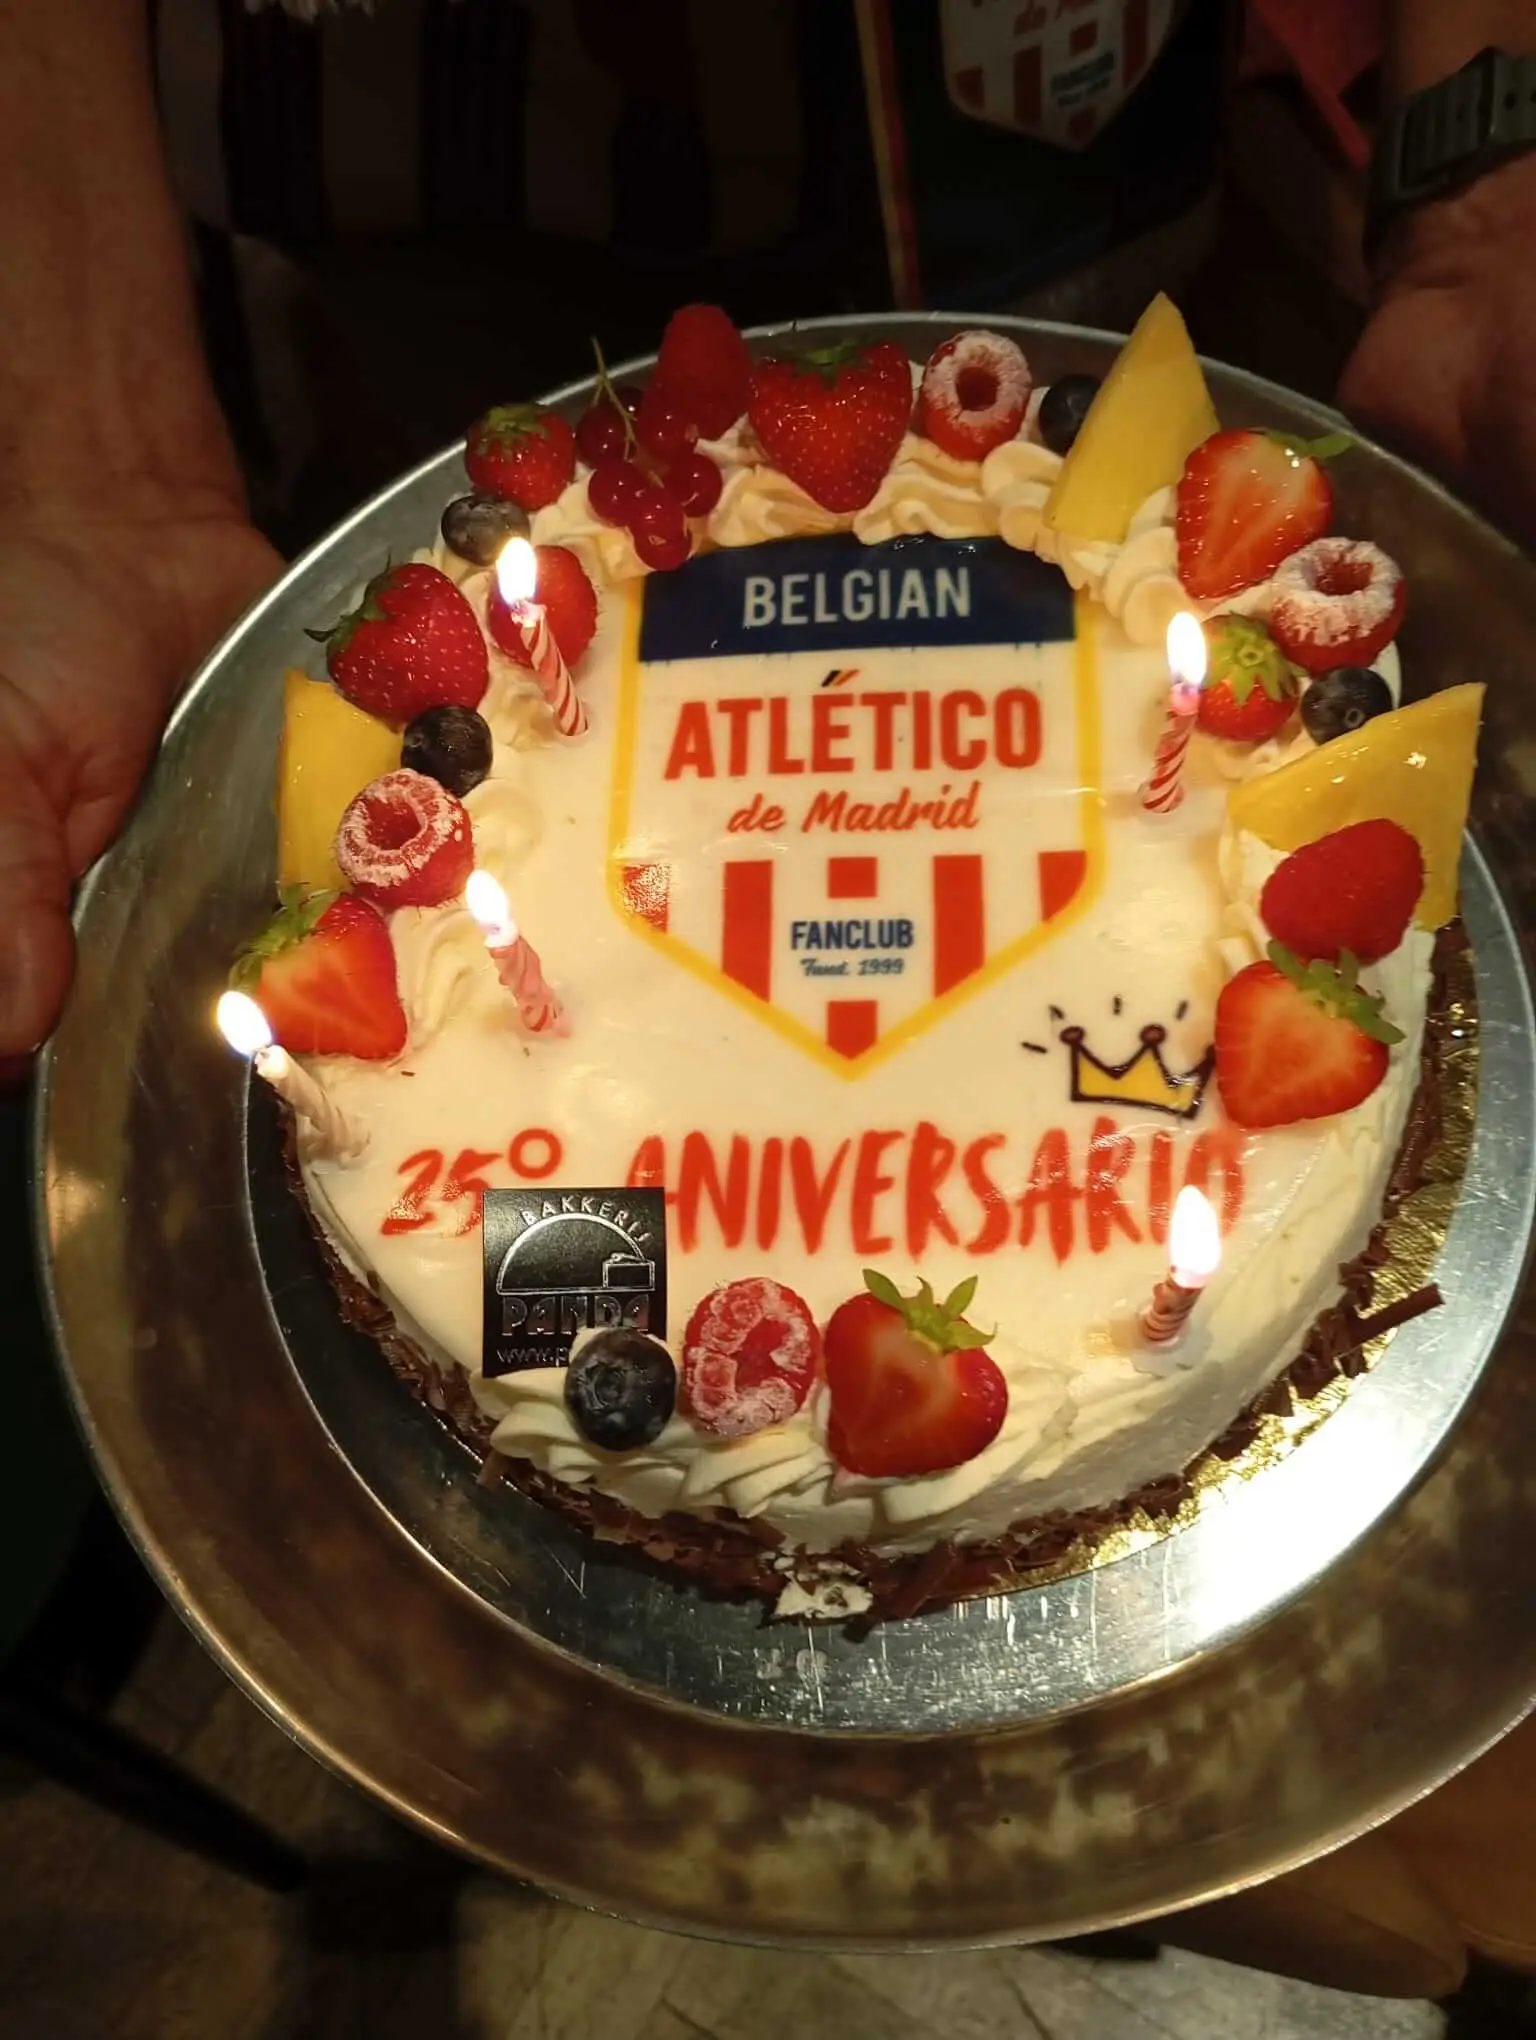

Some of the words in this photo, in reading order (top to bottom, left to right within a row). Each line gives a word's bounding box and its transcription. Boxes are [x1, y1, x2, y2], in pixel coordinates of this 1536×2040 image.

[742, 567, 971, 627] BELGIAN
[664, 669, 1043, 781] ATLÉTICO
[727, 793, 785, 833] de
[802, 781, 980, 833] Madrid
[791, 918, 914, 950] FANCLUB
[857, 957, 905, 977] 1999
[501, 1294, 650, 1336] PANDA
